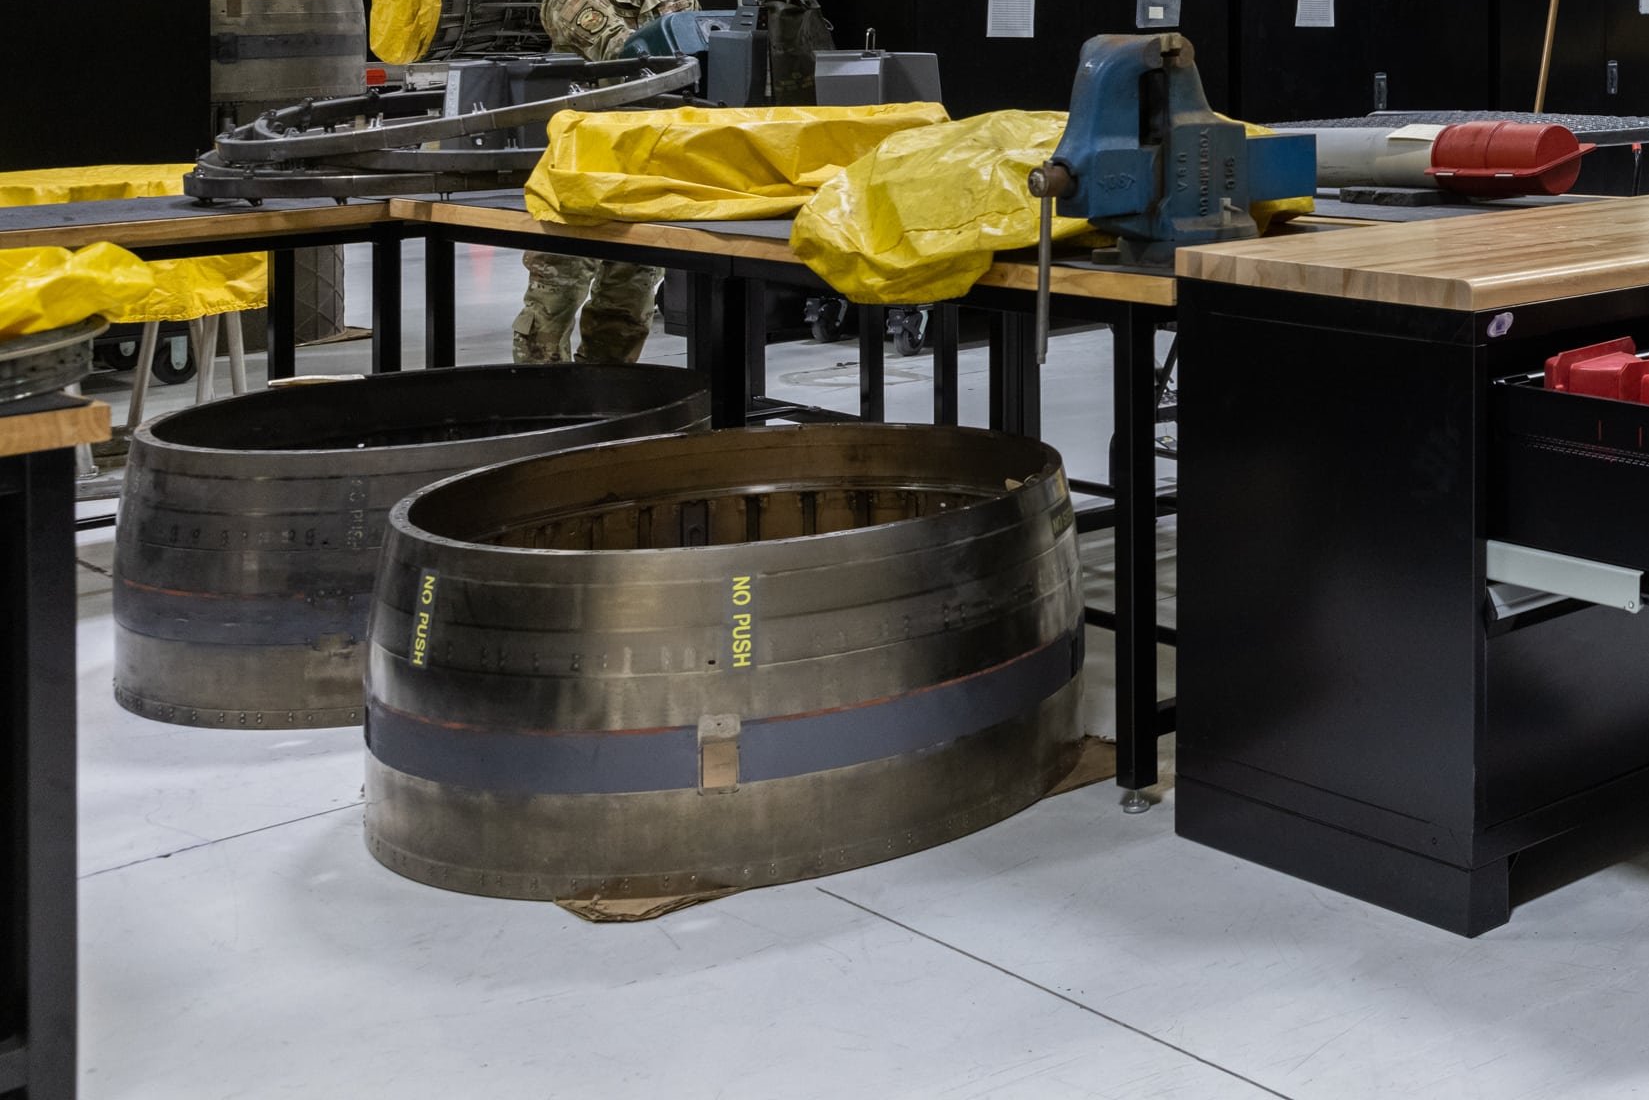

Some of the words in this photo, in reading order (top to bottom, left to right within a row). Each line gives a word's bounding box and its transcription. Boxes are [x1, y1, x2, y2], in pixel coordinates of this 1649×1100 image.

[421, 575, 436, 605] NO
[732, 576, 751, 606] NO
[413, 612, 430, 665] PUSH
[732, 613, 751, 667] PUSH
